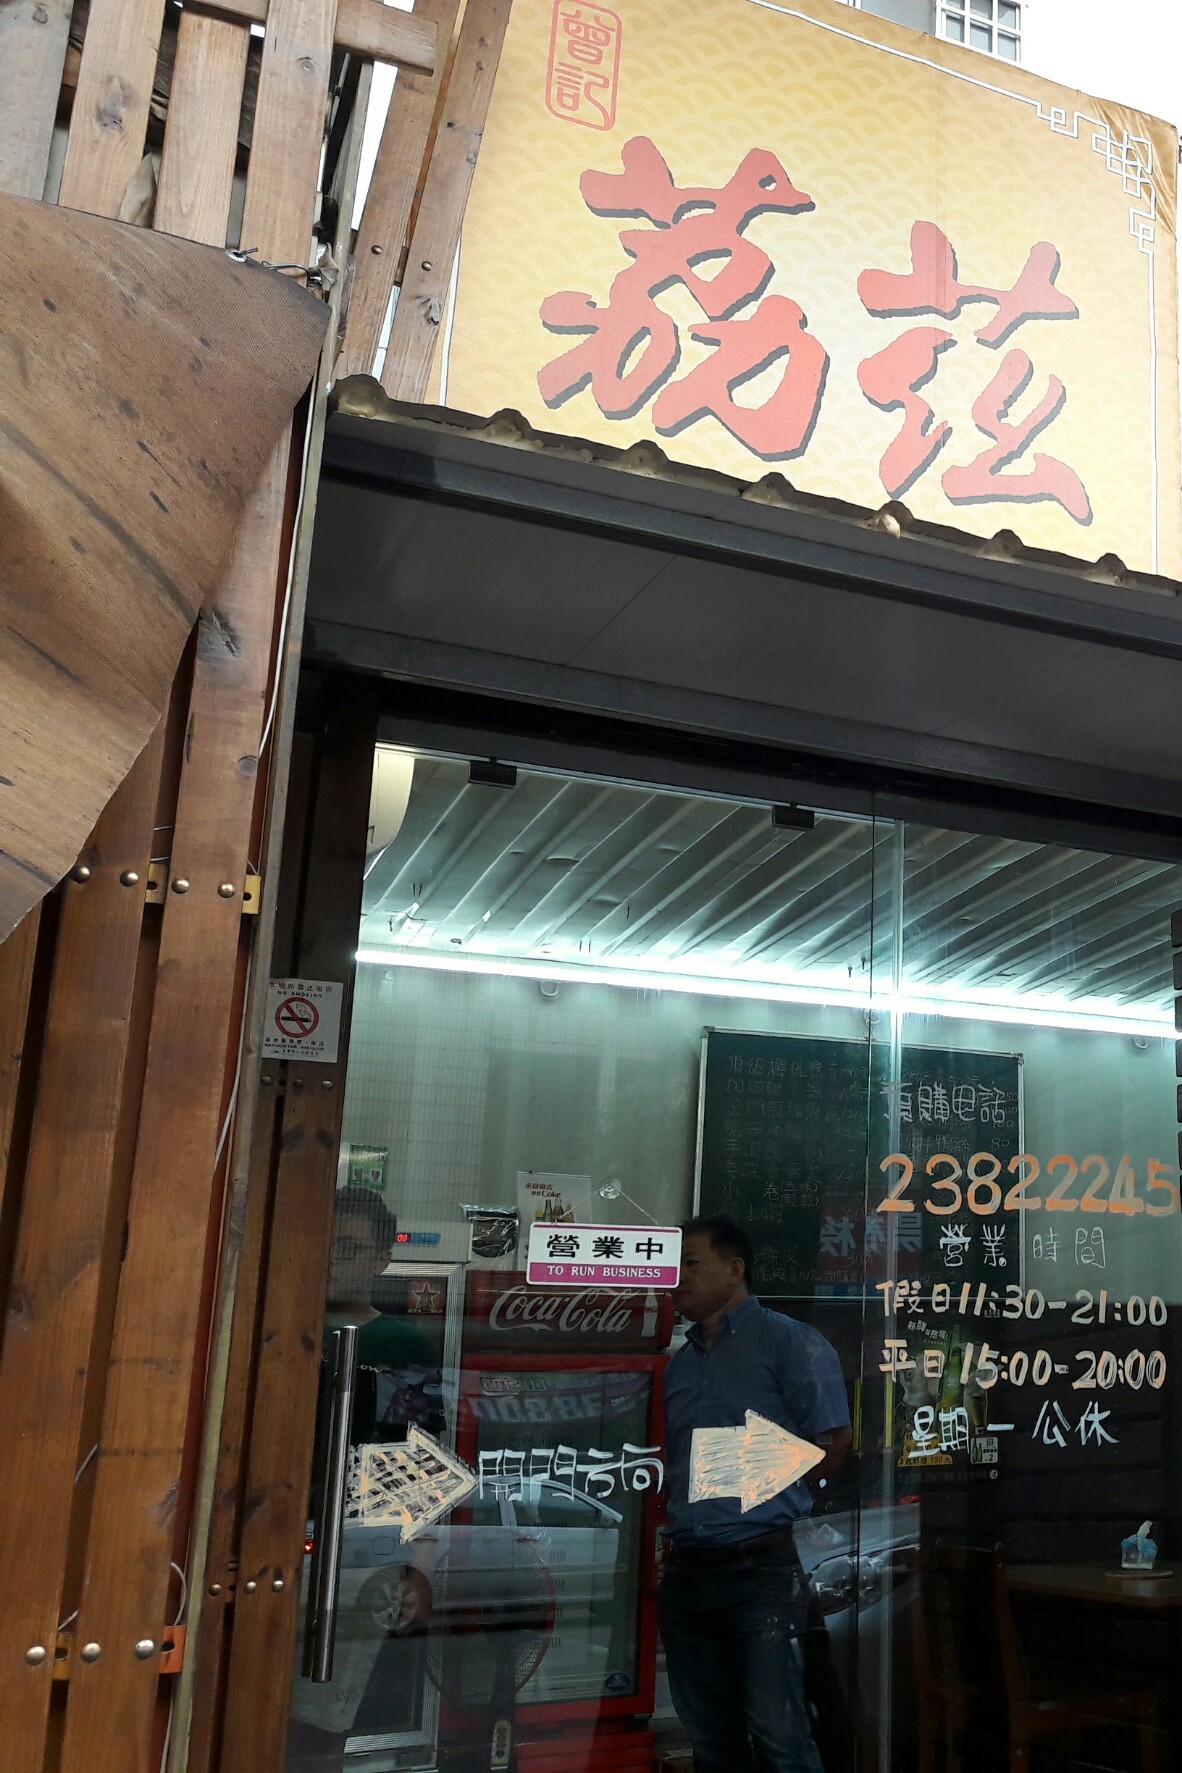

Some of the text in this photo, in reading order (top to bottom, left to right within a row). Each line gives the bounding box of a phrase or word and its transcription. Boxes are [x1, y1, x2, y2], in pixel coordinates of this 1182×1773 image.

[554, 8, 616, 129] 曾記
[291, 991, 323, 999] SMOKING
[876, 1152, 1180, 1216] 23822245
[546, 1233, 665, 1261] 營業中
[940, 1223, 1105, 1268] 營業時間
[547, 1265, 662, 1279] TO RUN BUSINESS
[489, 1284, 634, 1334] Coca-Cola
